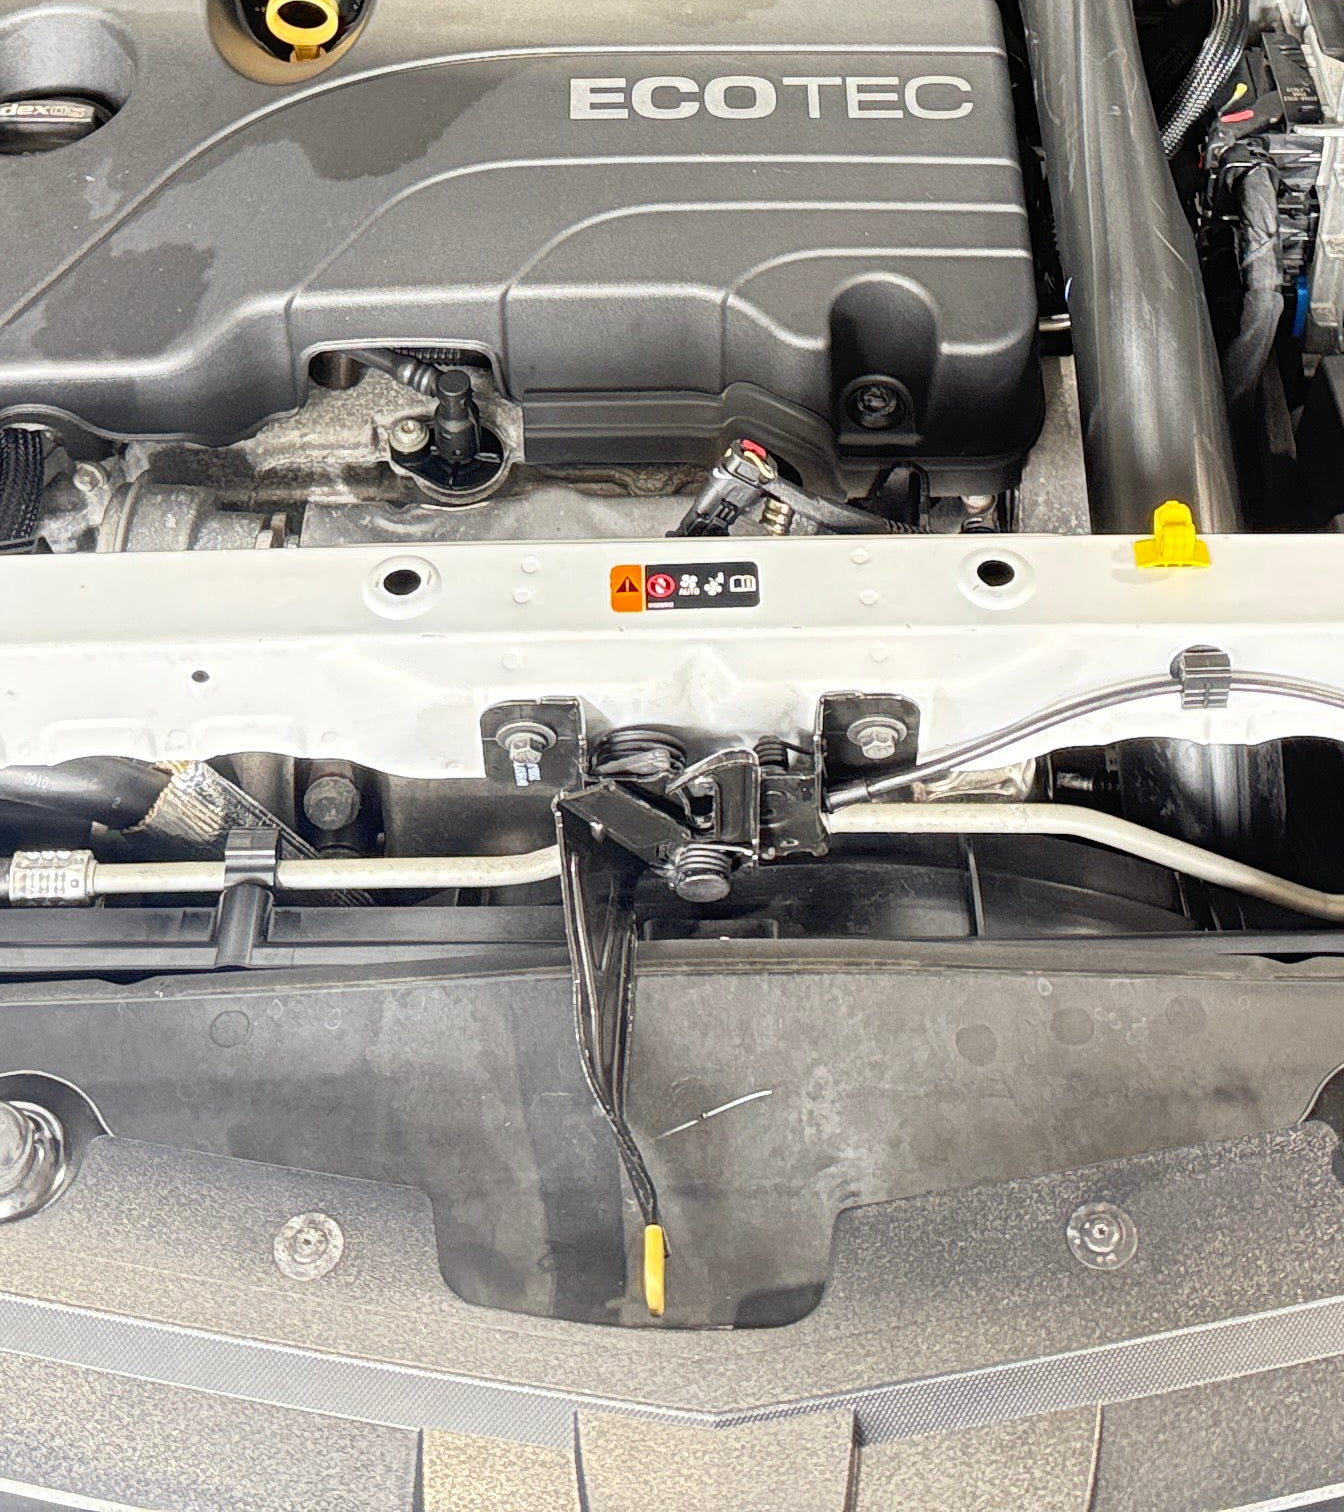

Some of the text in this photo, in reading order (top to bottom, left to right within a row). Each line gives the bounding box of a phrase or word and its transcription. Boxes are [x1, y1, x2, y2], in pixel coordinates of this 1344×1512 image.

[569, 75, 974, 120] ECOTEC
[0, 103, 86, 118] dexos
[678, 587, 701, 596] AUTO
